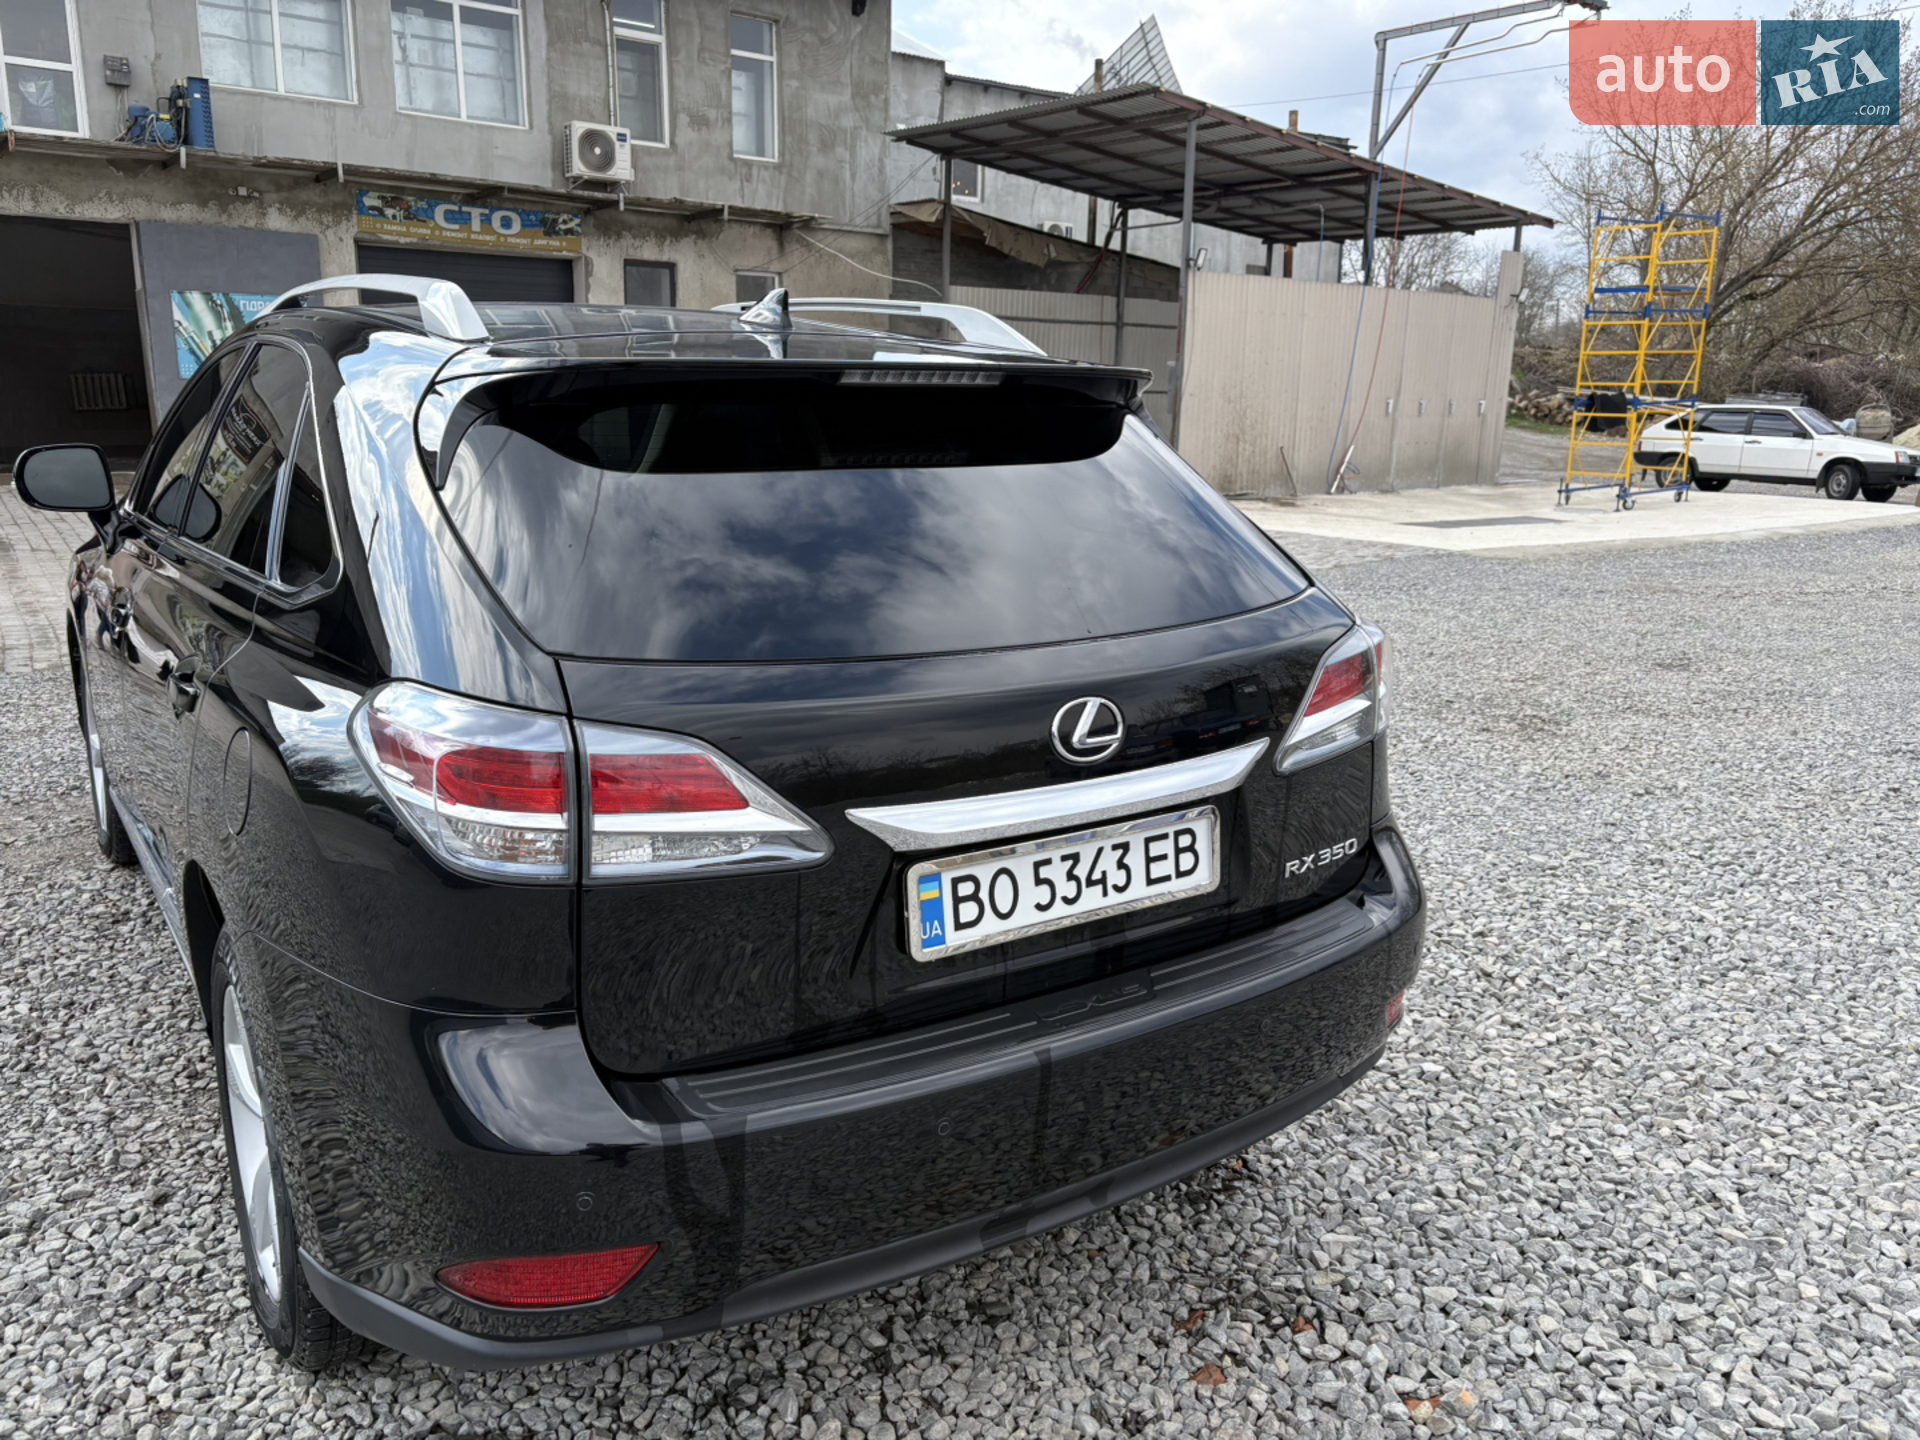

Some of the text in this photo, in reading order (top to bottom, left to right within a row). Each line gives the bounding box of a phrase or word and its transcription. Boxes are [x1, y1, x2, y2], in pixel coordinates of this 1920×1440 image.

[434, 204, 522, 236] СТО
[442, 230, 468, 239] РЕМОНТ
[507, 236, 531, 245] РЕМОНТ
[1284, 837, 1358, 879] RX 350
[950, 827, 1200, 933] BO 5343 EB
[919, 919, 943, 940] UA
